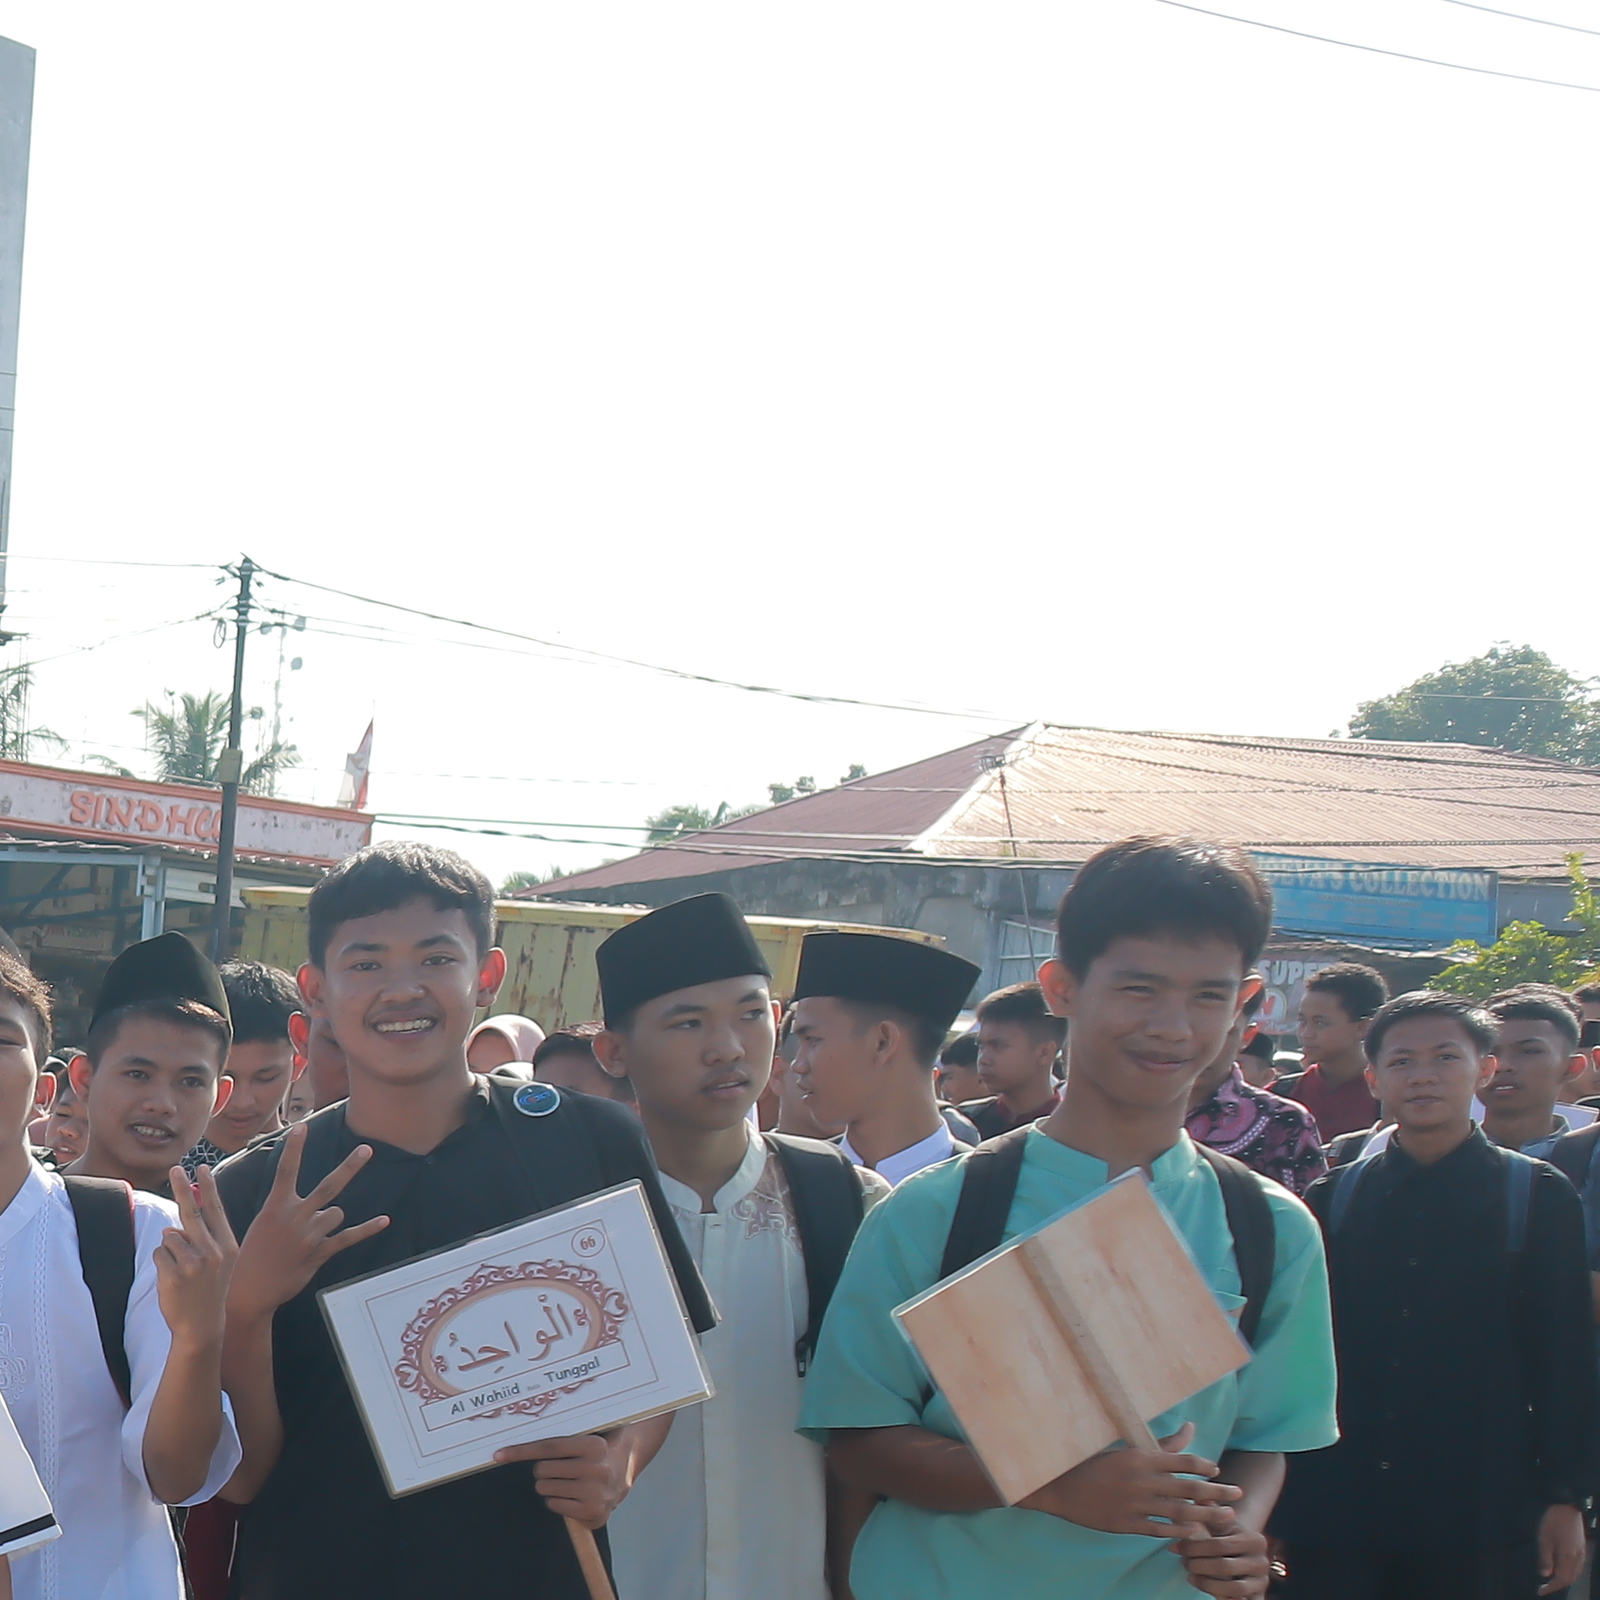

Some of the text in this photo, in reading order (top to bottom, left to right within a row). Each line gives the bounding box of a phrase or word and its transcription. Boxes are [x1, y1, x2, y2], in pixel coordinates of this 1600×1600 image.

[579, 1235, 597, 1250] 66
[451, 1356, 600, 1415] Al Wahiid Tunggal
